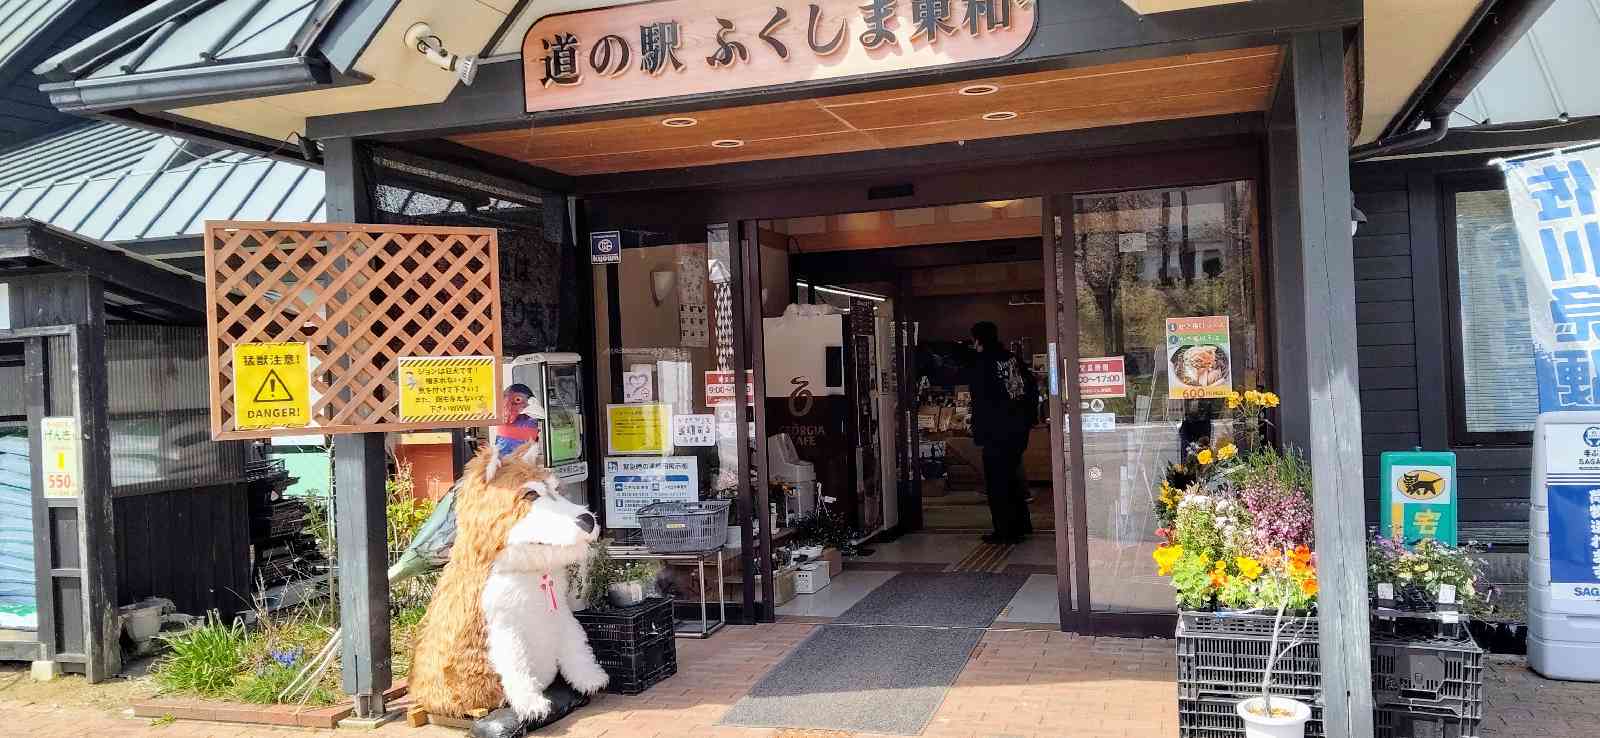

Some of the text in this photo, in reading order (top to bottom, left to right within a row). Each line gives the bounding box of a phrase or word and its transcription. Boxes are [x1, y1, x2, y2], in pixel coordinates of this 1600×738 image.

[540, 18, 686, 88] 道の駅
[247, 409, 300, 419] DANGER!
[48, 474, 72, 489] 550
